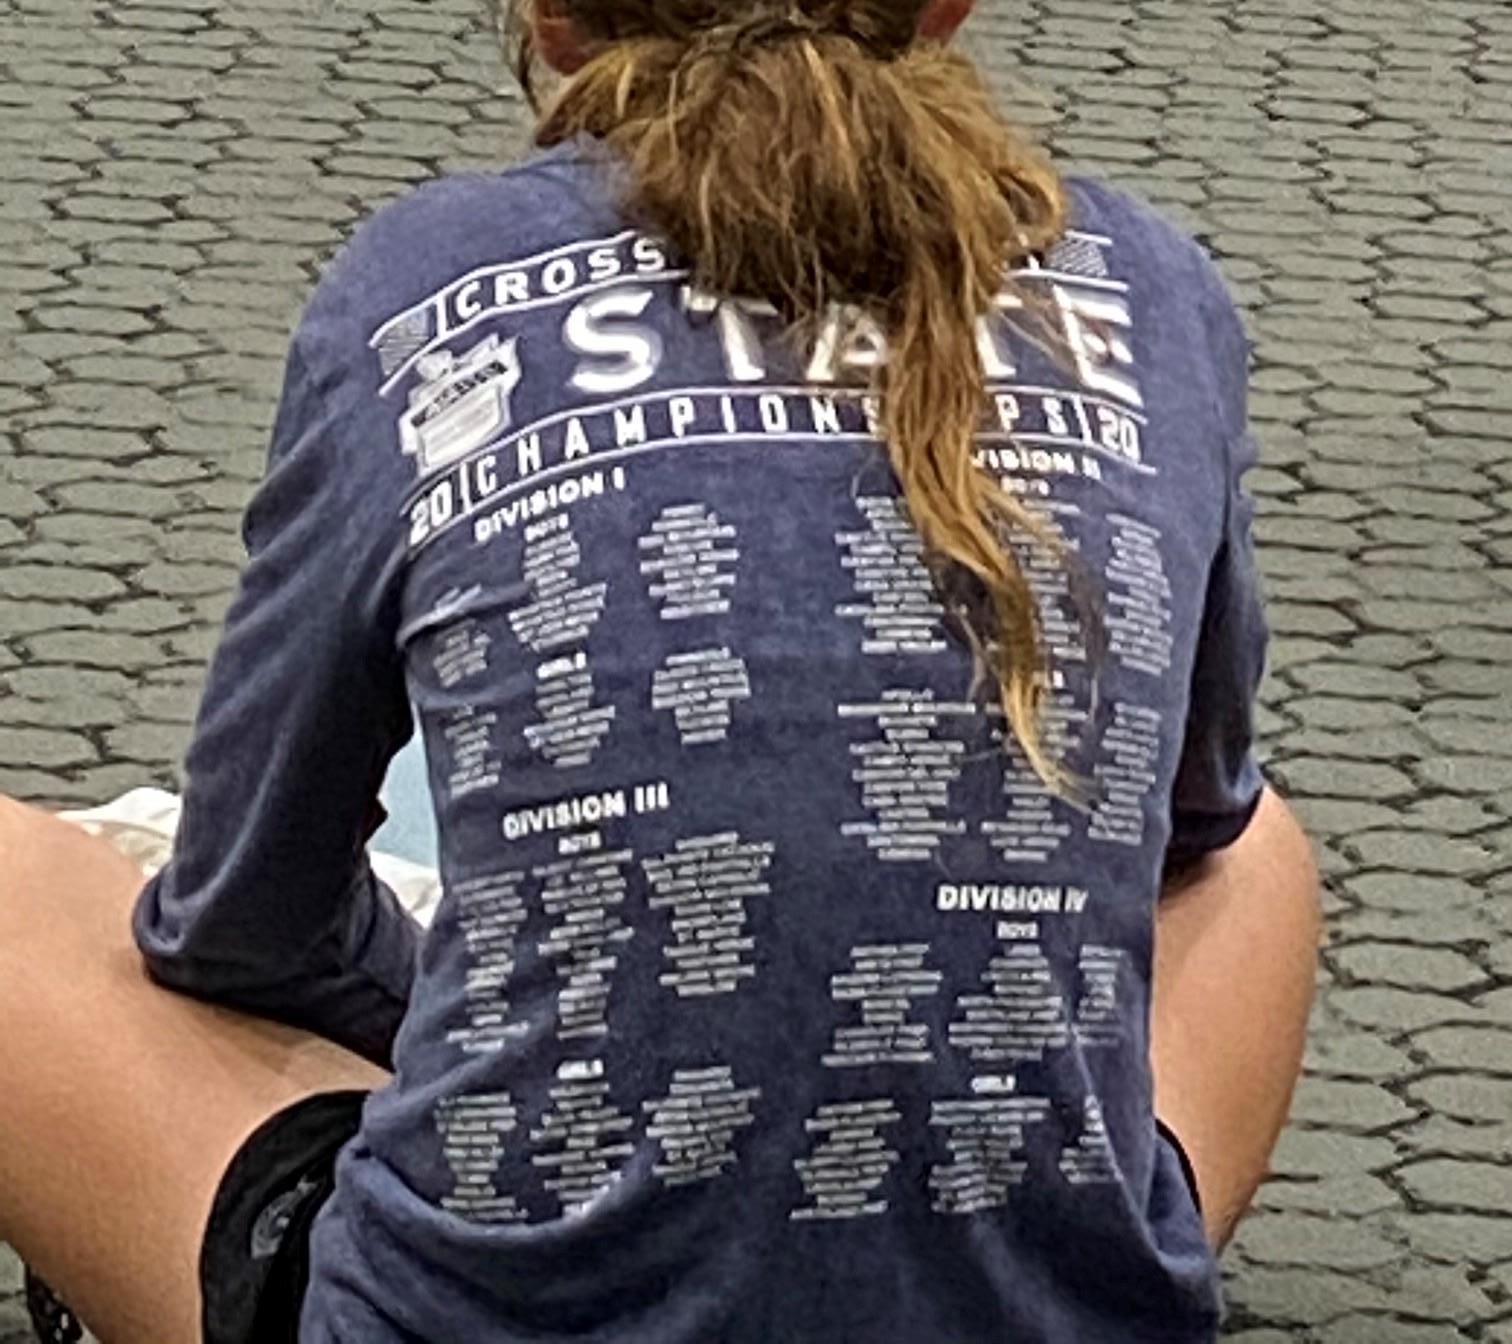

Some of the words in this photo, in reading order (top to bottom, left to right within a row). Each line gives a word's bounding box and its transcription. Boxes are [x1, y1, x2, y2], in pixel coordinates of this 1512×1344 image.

[455, 237, 666, 320] CROSS
[409, 480, 452, 547] 20
[1096, 406, 1141, 463] 20
[474, 472, 604, 543] DIVISION
[612, 466, 625, 491] I
[503, 790, 625, 841] DIVISION
[633, 782, 670, 814] III
[937, 884, 1062, 913] DIVISION
[1064, 885, 1089, 913] IV
